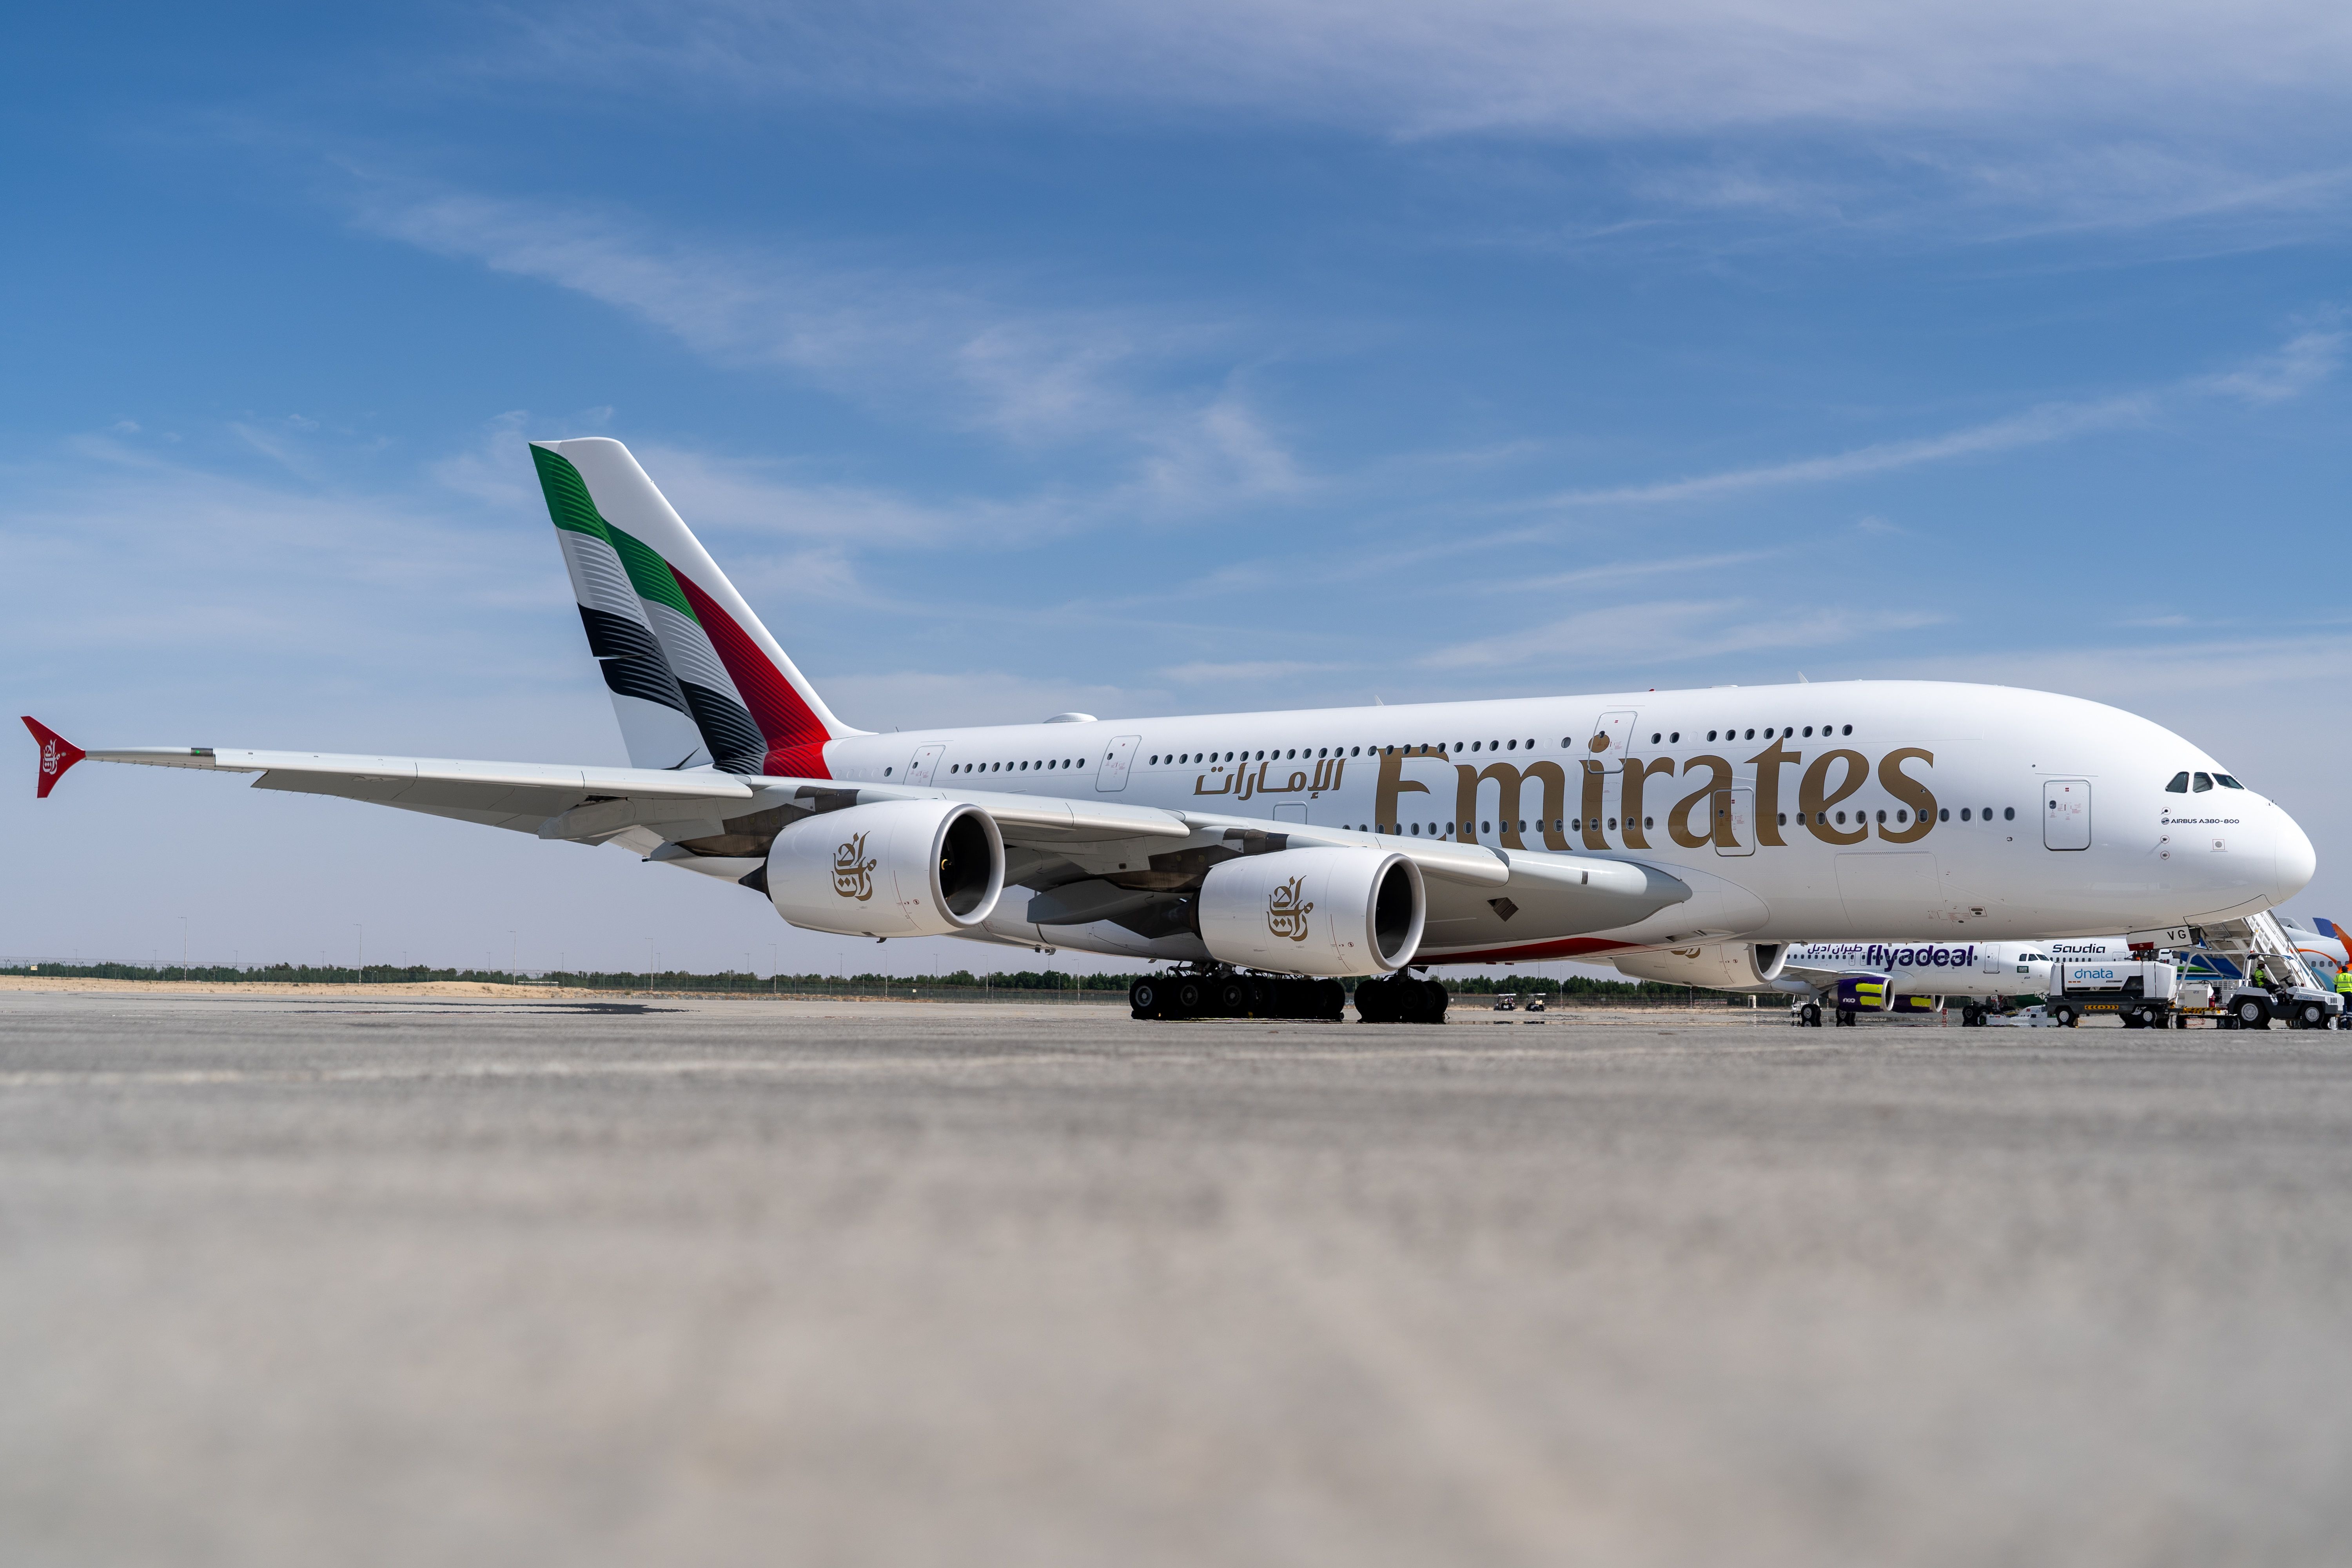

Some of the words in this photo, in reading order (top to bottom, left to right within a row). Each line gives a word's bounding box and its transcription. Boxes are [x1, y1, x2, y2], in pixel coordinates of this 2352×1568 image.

[1193, 758, 1347, 800] الإمارات
[1375, 734, 1938, 851] Emirates
[2167, 929, 2187, 940] VG
[1867, 944, 1974, 972] flyadeal
[2052, 944, 2106, 953] Saudia
[2074, 968, 2113, 979] dnata
